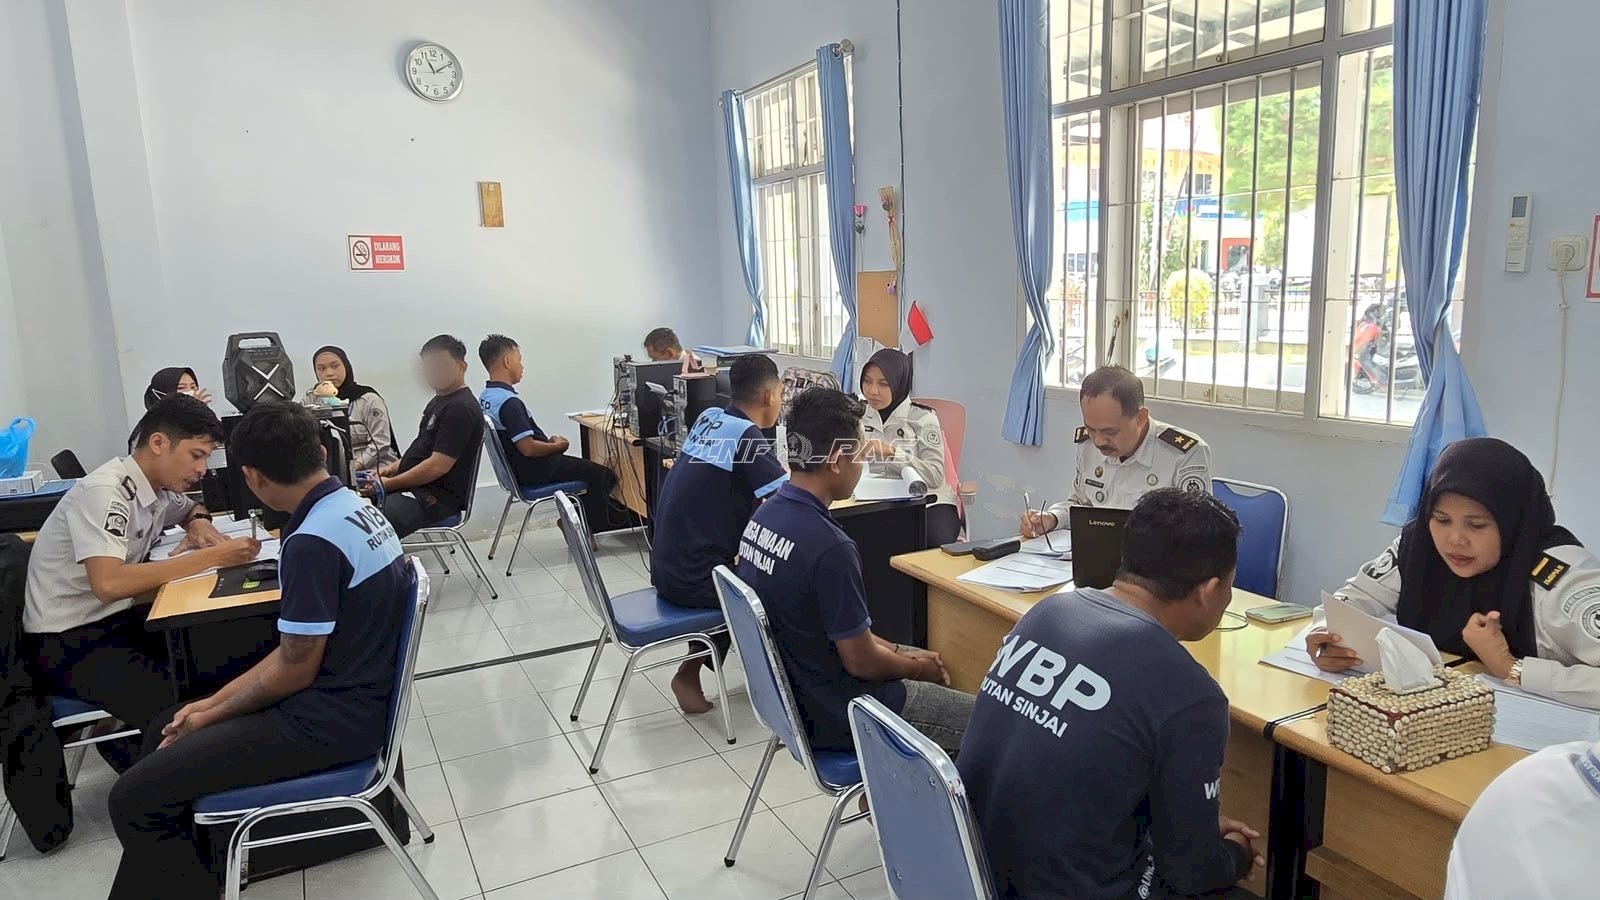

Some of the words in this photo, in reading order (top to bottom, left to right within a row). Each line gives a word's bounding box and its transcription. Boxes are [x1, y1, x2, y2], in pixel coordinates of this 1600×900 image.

[429, 49, 437, 58] 12
[414, 58, 423, 66] 10
[447, 60, 453, 68] 2
[411, 67, 417, 75] 9
[451, 71, 457, 79] 3
[416, 78, 422, 86] 8
[449, 80, 455, 88] 4
[433, 88, 439, 96] 6
[443, 86, 449, 94] 5
[344, 505, 387, 535] WB
[1088, 519, 1116, 527] Lenovo
[1011, 696, 1068, 738] SINJAI
